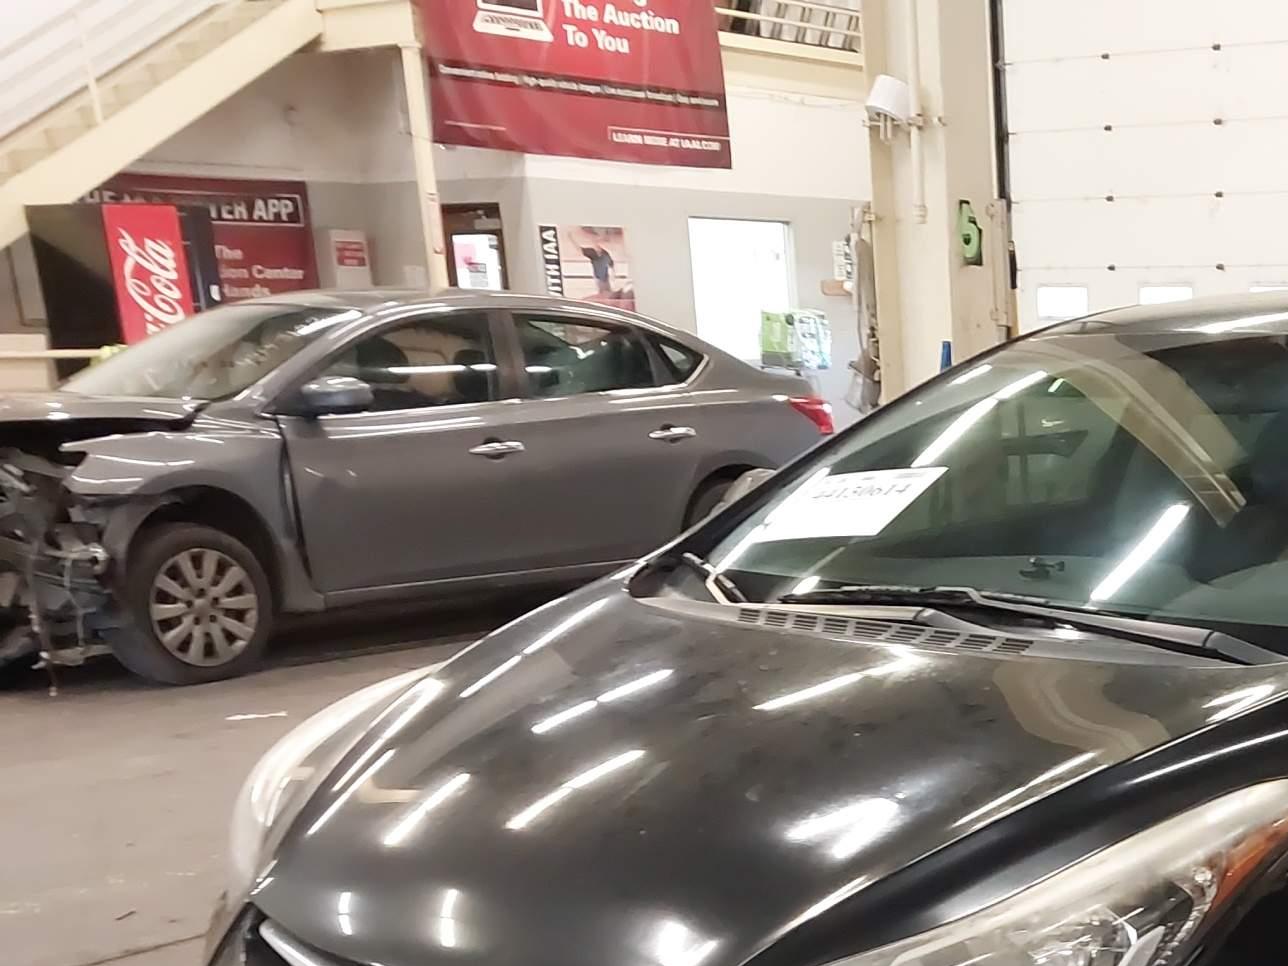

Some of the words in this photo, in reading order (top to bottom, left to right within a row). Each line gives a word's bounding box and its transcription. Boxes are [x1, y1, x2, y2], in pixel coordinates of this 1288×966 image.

[561, 0, 598, 22] The
[603, 4, 680, 35] Auction
[562, 24, 589, 48] To
[592, 28, 631, 54] You
[252, 198, 294, 222] APP
